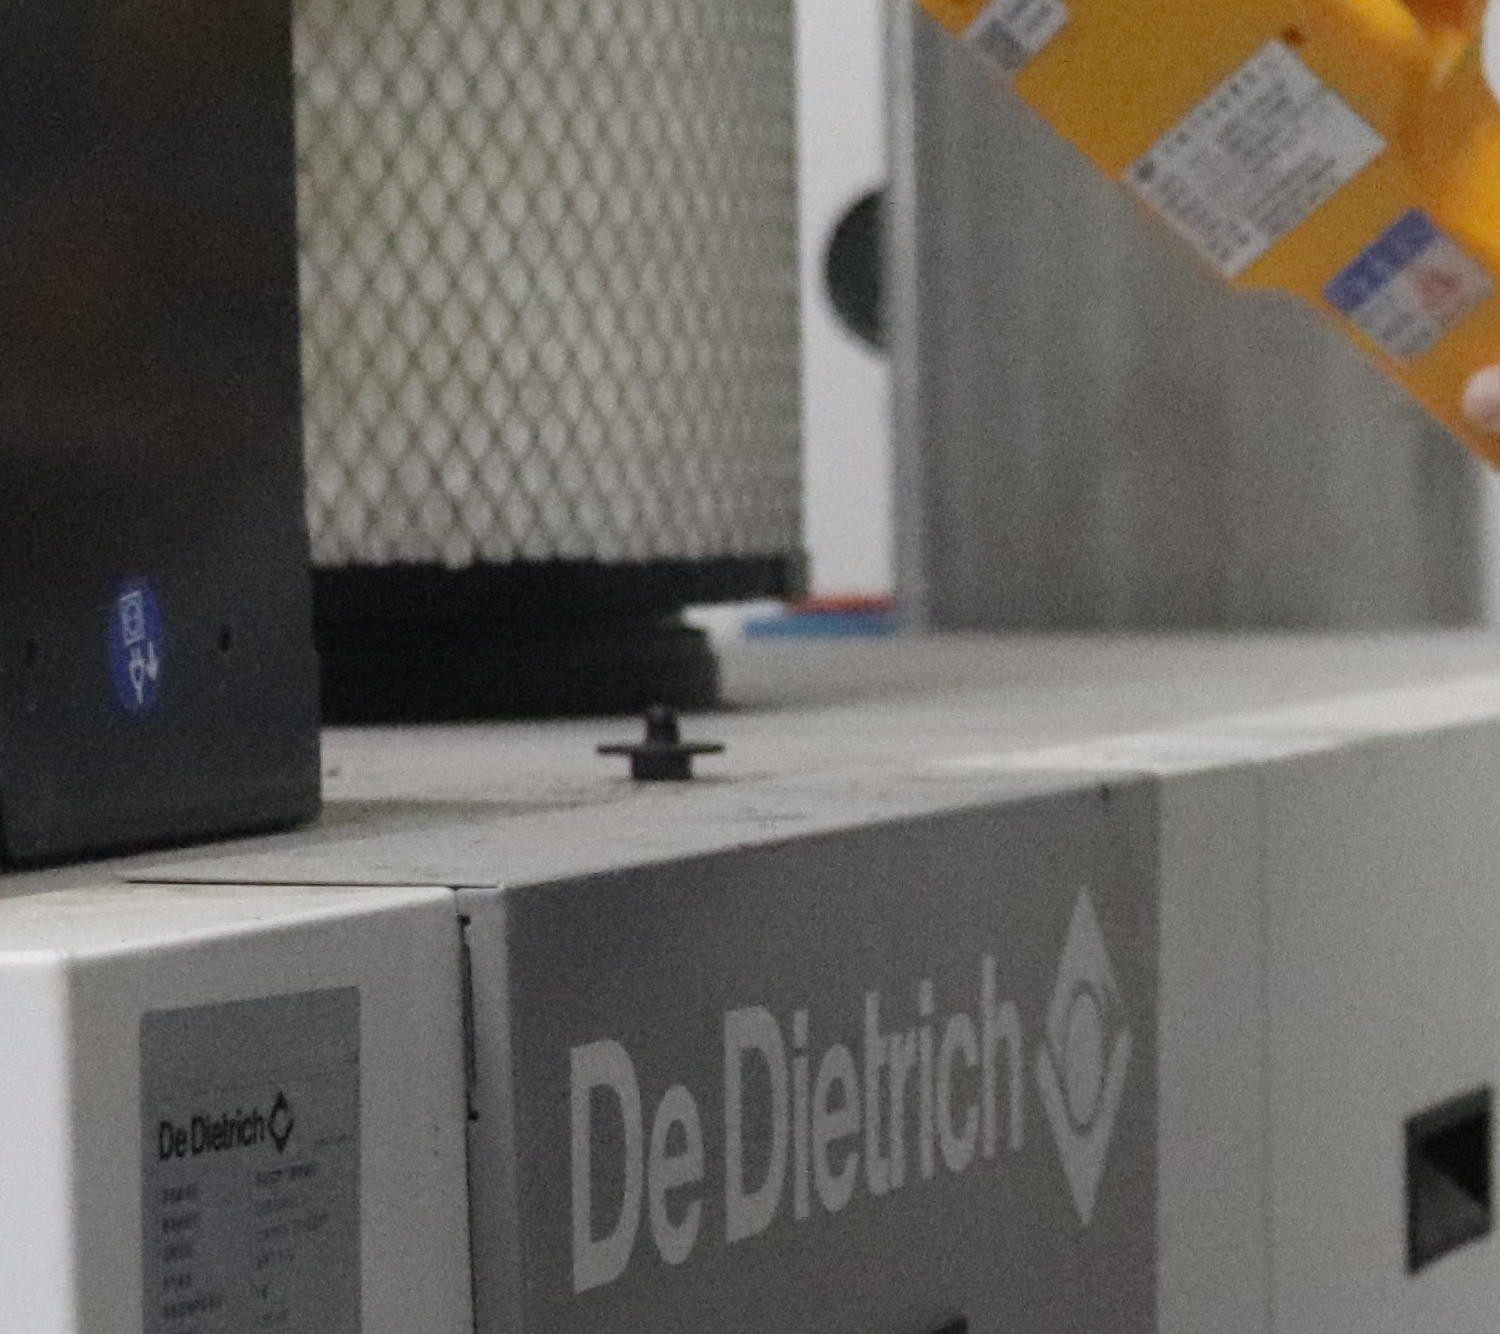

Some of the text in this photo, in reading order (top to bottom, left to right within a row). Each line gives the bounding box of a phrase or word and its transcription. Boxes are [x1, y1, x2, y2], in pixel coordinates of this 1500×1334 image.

[157, 1107, 266, 1161] De Dietrich
[570, 953, 1025, 1295] De Dietrich
